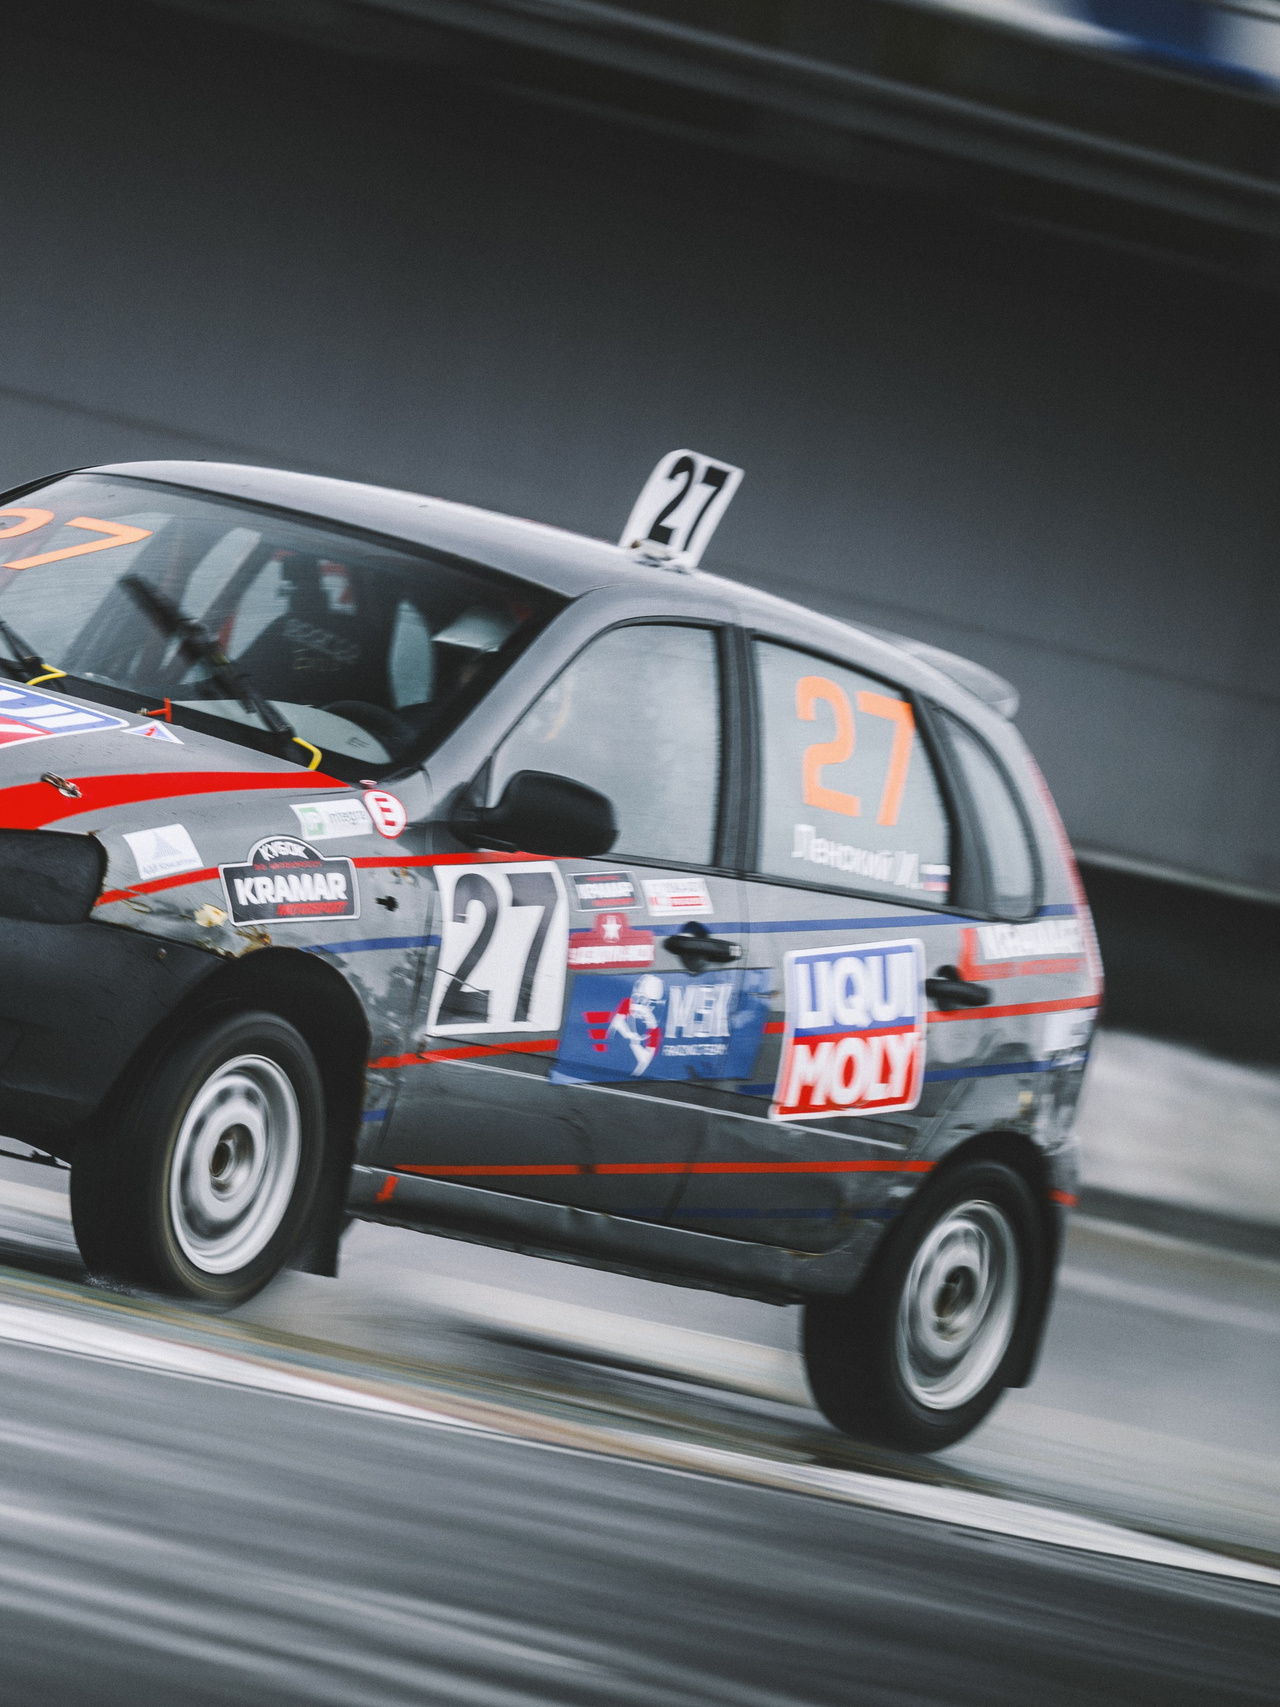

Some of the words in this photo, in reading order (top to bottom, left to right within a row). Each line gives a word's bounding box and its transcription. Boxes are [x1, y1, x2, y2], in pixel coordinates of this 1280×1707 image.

[647, 455, 730, 552] 27
[795, 675, 916, 827] 27
[373, 797, 397, 827] E
[233, 872, 349, 906] KRAMAR
[437, 871, 558, 1027] 27
[795, 952, 915, 1029] LIQUI
[786, 1032, 920, 1107] MOLY
